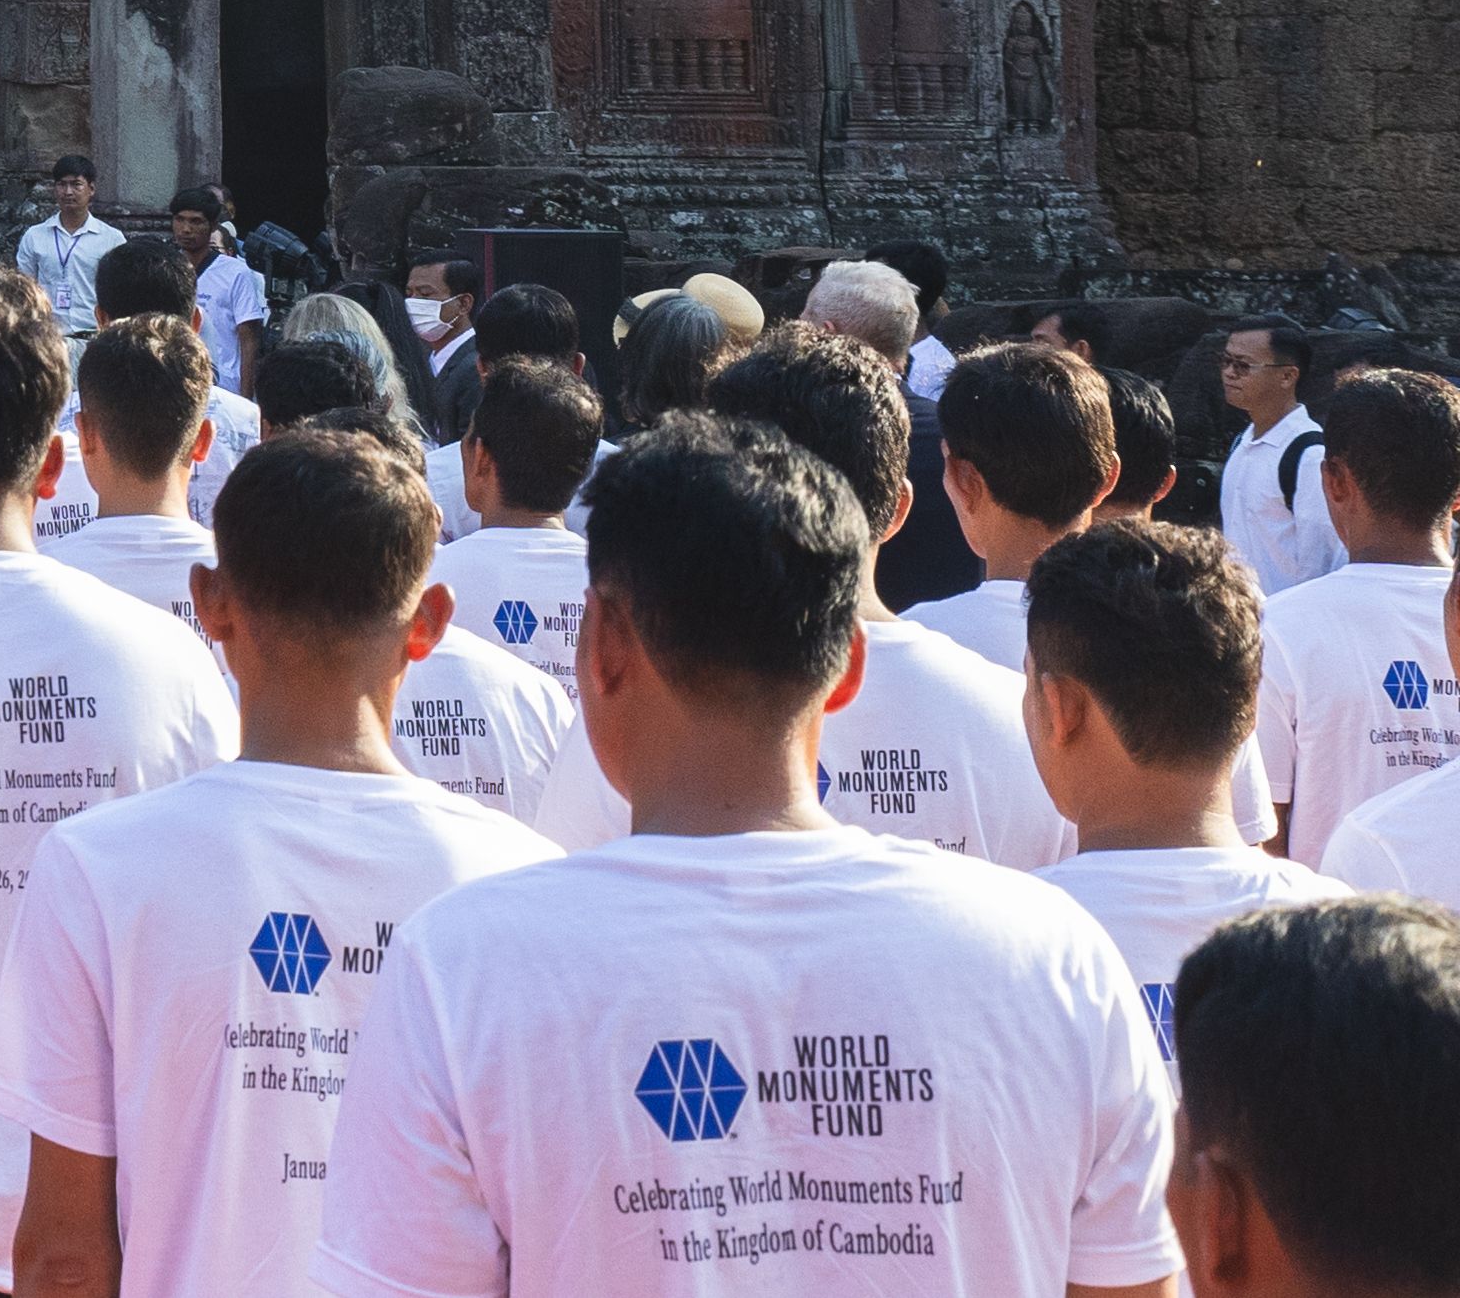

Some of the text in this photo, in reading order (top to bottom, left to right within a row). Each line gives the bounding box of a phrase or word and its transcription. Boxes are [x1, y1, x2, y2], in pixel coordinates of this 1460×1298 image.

[51, 503, 90, 520] WORLD
[36, 516, 99, 537] MONUME
[559, 603, 584, 617] WOR
[565, 633, 578, 647] FU
[9, 675, 68, 699] WORLD
[412, 700, 463, 718] WORLD
[20, 721, 65, 744] FUND
[395, 718, 486, 737] MONUMENTS
[422, 737, 461, 756] FUND
[861, 749, 921, 770] WORLD
[1386, 751, 1396, 767] in
[5, 768, 83, 790] Monuments
[86, 767, 117, 788] Fund
[437, 777, 504, 795] ments Fund
[839, 770, 948, 793] MONUMENTS
[13, 802, 26, 822] of
[29, 801, 87, 823] Cambod
[871, 793, 916, 814] FUND
[224, 1021, 348, 1058] Celebrating World
[794, 1035, 890, 1068] WORLD
[242, 1064, 256, 1089] in
[261, 1064, 287, 1091] the
[757, 1068, 934, 1103] MONUMENTS
[812, 1105, 883, 1137] FUND
[282, 1153, 327, 1184] Janua
[613, 1170, 963, 1216] Celebrating World Monuments Fund
[659, 1220, 934, 1265] in the Kingdom of Cambodia
